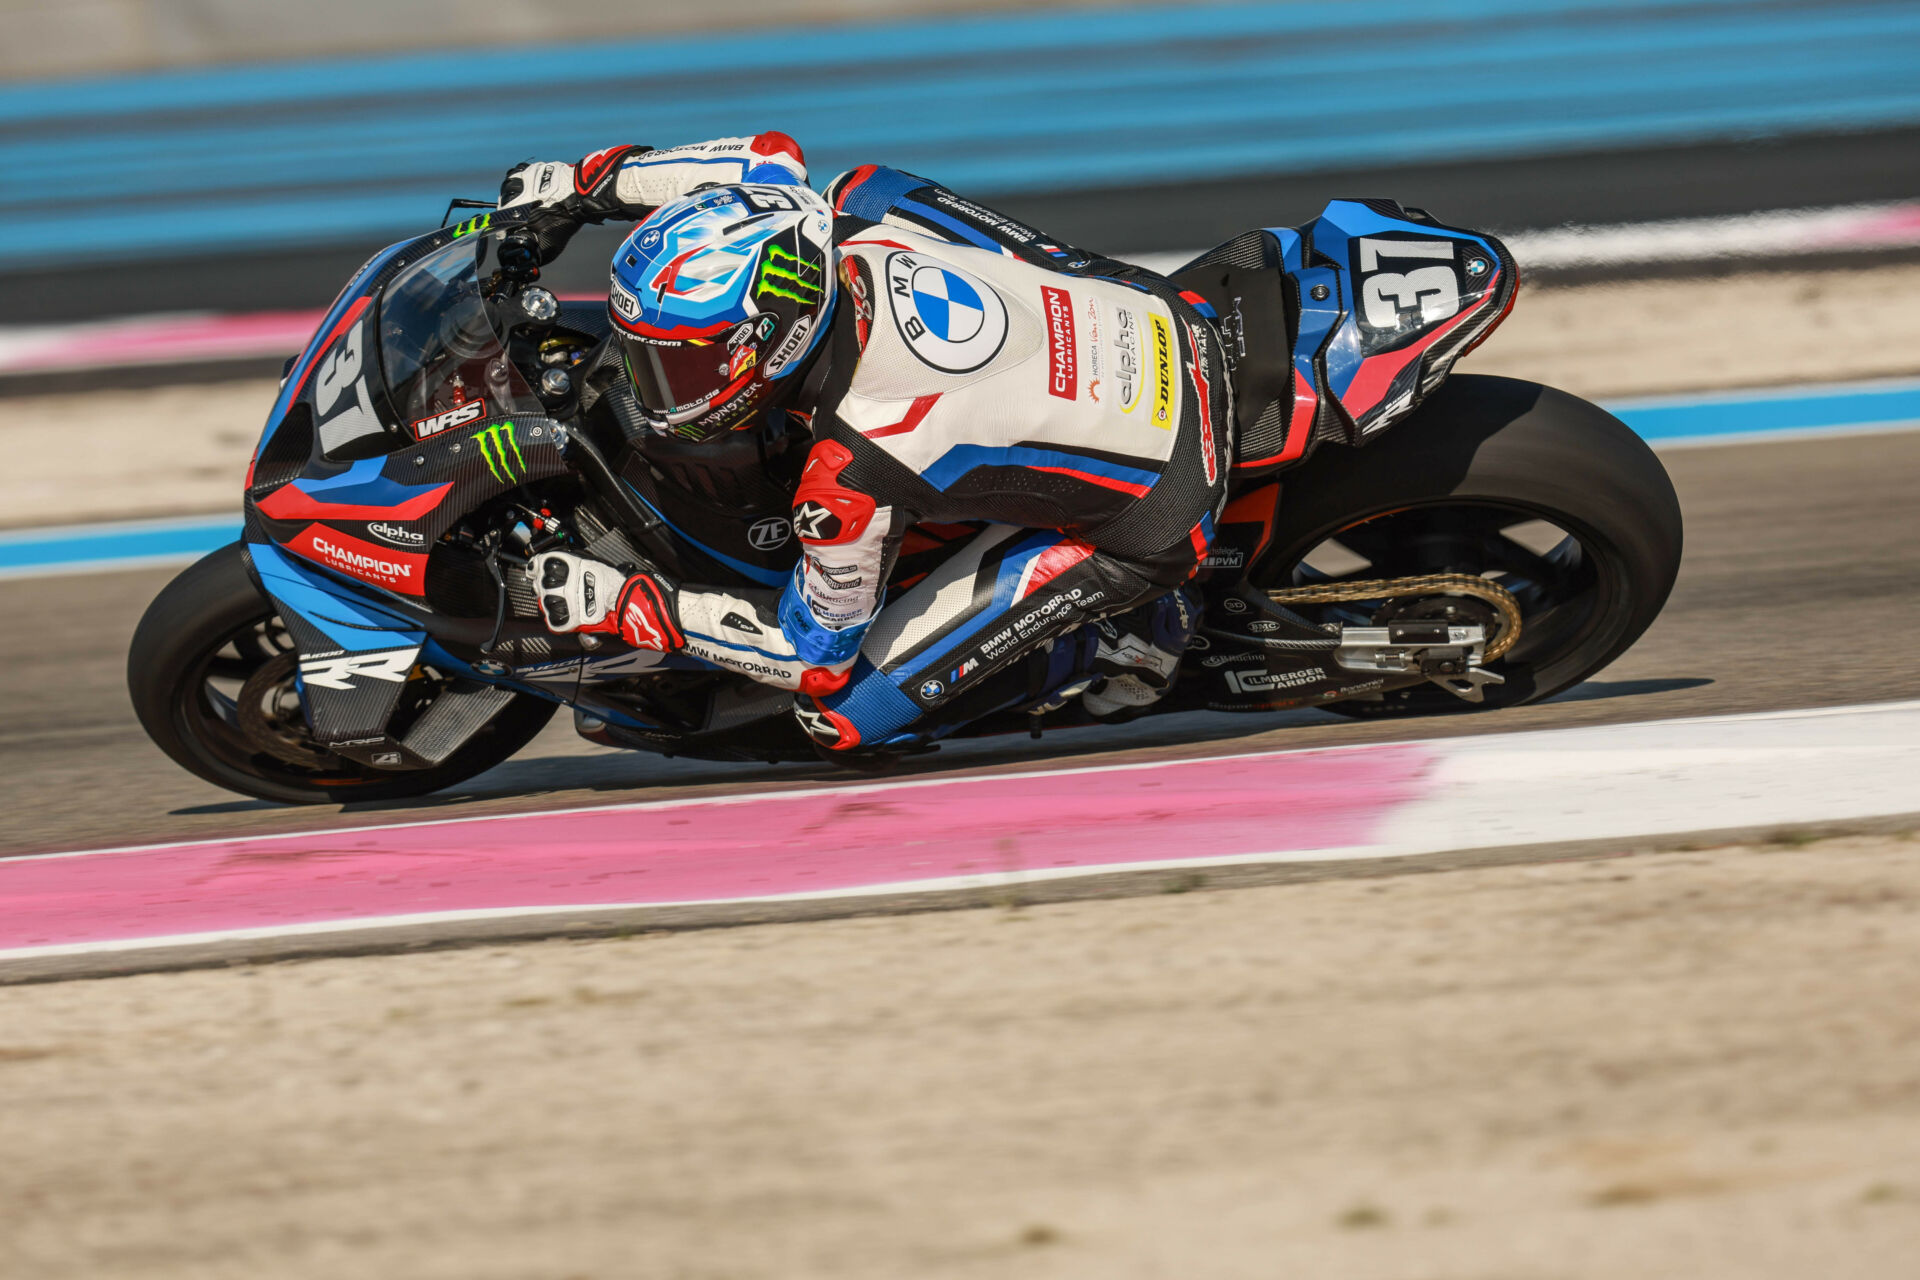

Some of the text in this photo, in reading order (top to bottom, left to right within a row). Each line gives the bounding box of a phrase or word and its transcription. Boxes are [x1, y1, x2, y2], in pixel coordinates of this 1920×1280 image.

[709, 144, 744, 153] BMW
[937, 196, 1030, 243] BMW MOTORRAD
[1005, 222, 1037, 240] World
[611, 283, 635, 315] SHOEI
[893, 254, 926, 341] BMW
[1359, 237, 1460, 328] 37
[769, 324, 808, 370] SHOEI
[1047, 289, 1066, 393] CHAMPION
[1062, 305, 1073, 380] LUBRICANTS
[1090, 345, 1099, 376] HORECA
[1114, 308, 1137, 405] alpha
[1126, 311, 1137, 365] RACING
[1154, 318, 1170, 405] DUNLOP
[417, 401, 481, 438] WRS
[697, 382, 763, 427] MONSTER
[372, 522, 424, 541] alpha
[313, 536, 411, 577] CHAMPION
[325, 556, 397, 583] LUBRICANTS
[1215, 557, 1239, 566] PVM
[979, 627, 1013, 654] BMW
[1012, 588, 1082, 632] MOTORRAD
[985, 590, 1105, 661] World Endurance Team
[685, 643, 792, 679] MW MOTORRAD
[1248, 667, 1325, 685] ILMBERGER
